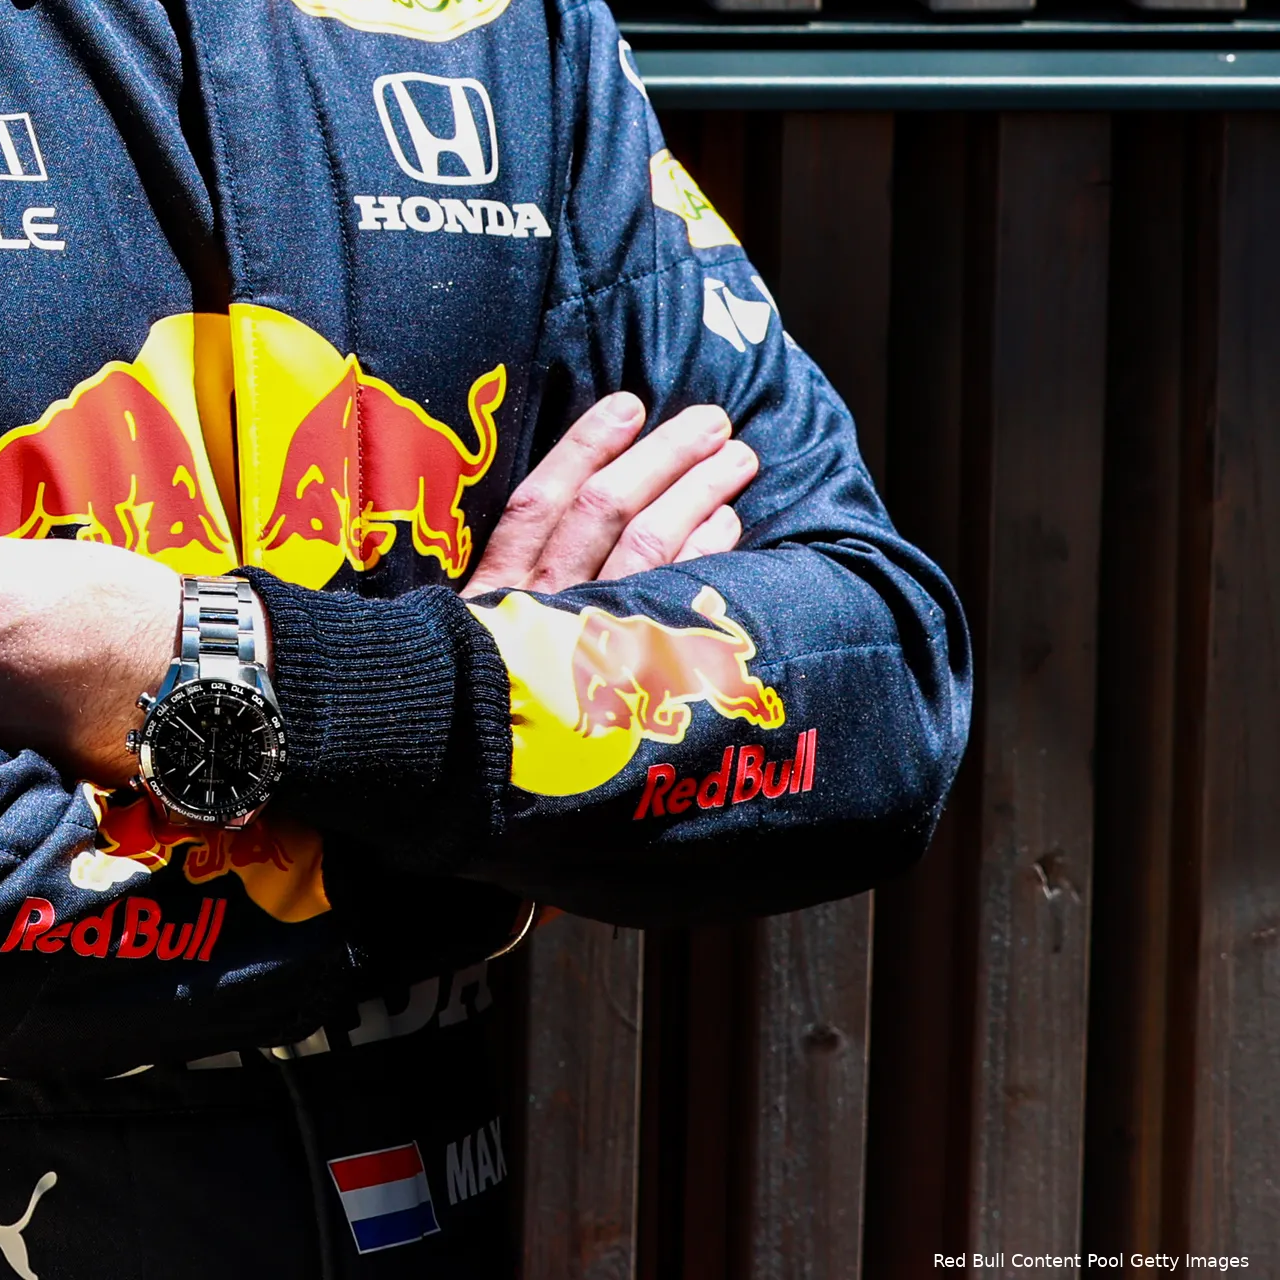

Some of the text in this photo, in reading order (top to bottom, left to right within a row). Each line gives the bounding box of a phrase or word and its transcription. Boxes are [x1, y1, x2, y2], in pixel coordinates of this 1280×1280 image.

[354, 195, 552, 239] HONDA
[633, 728, 818, 821] Red Bull
[0, 896, 227, 962] Red Bull
[446, 1116, 508, 1206] MAX
